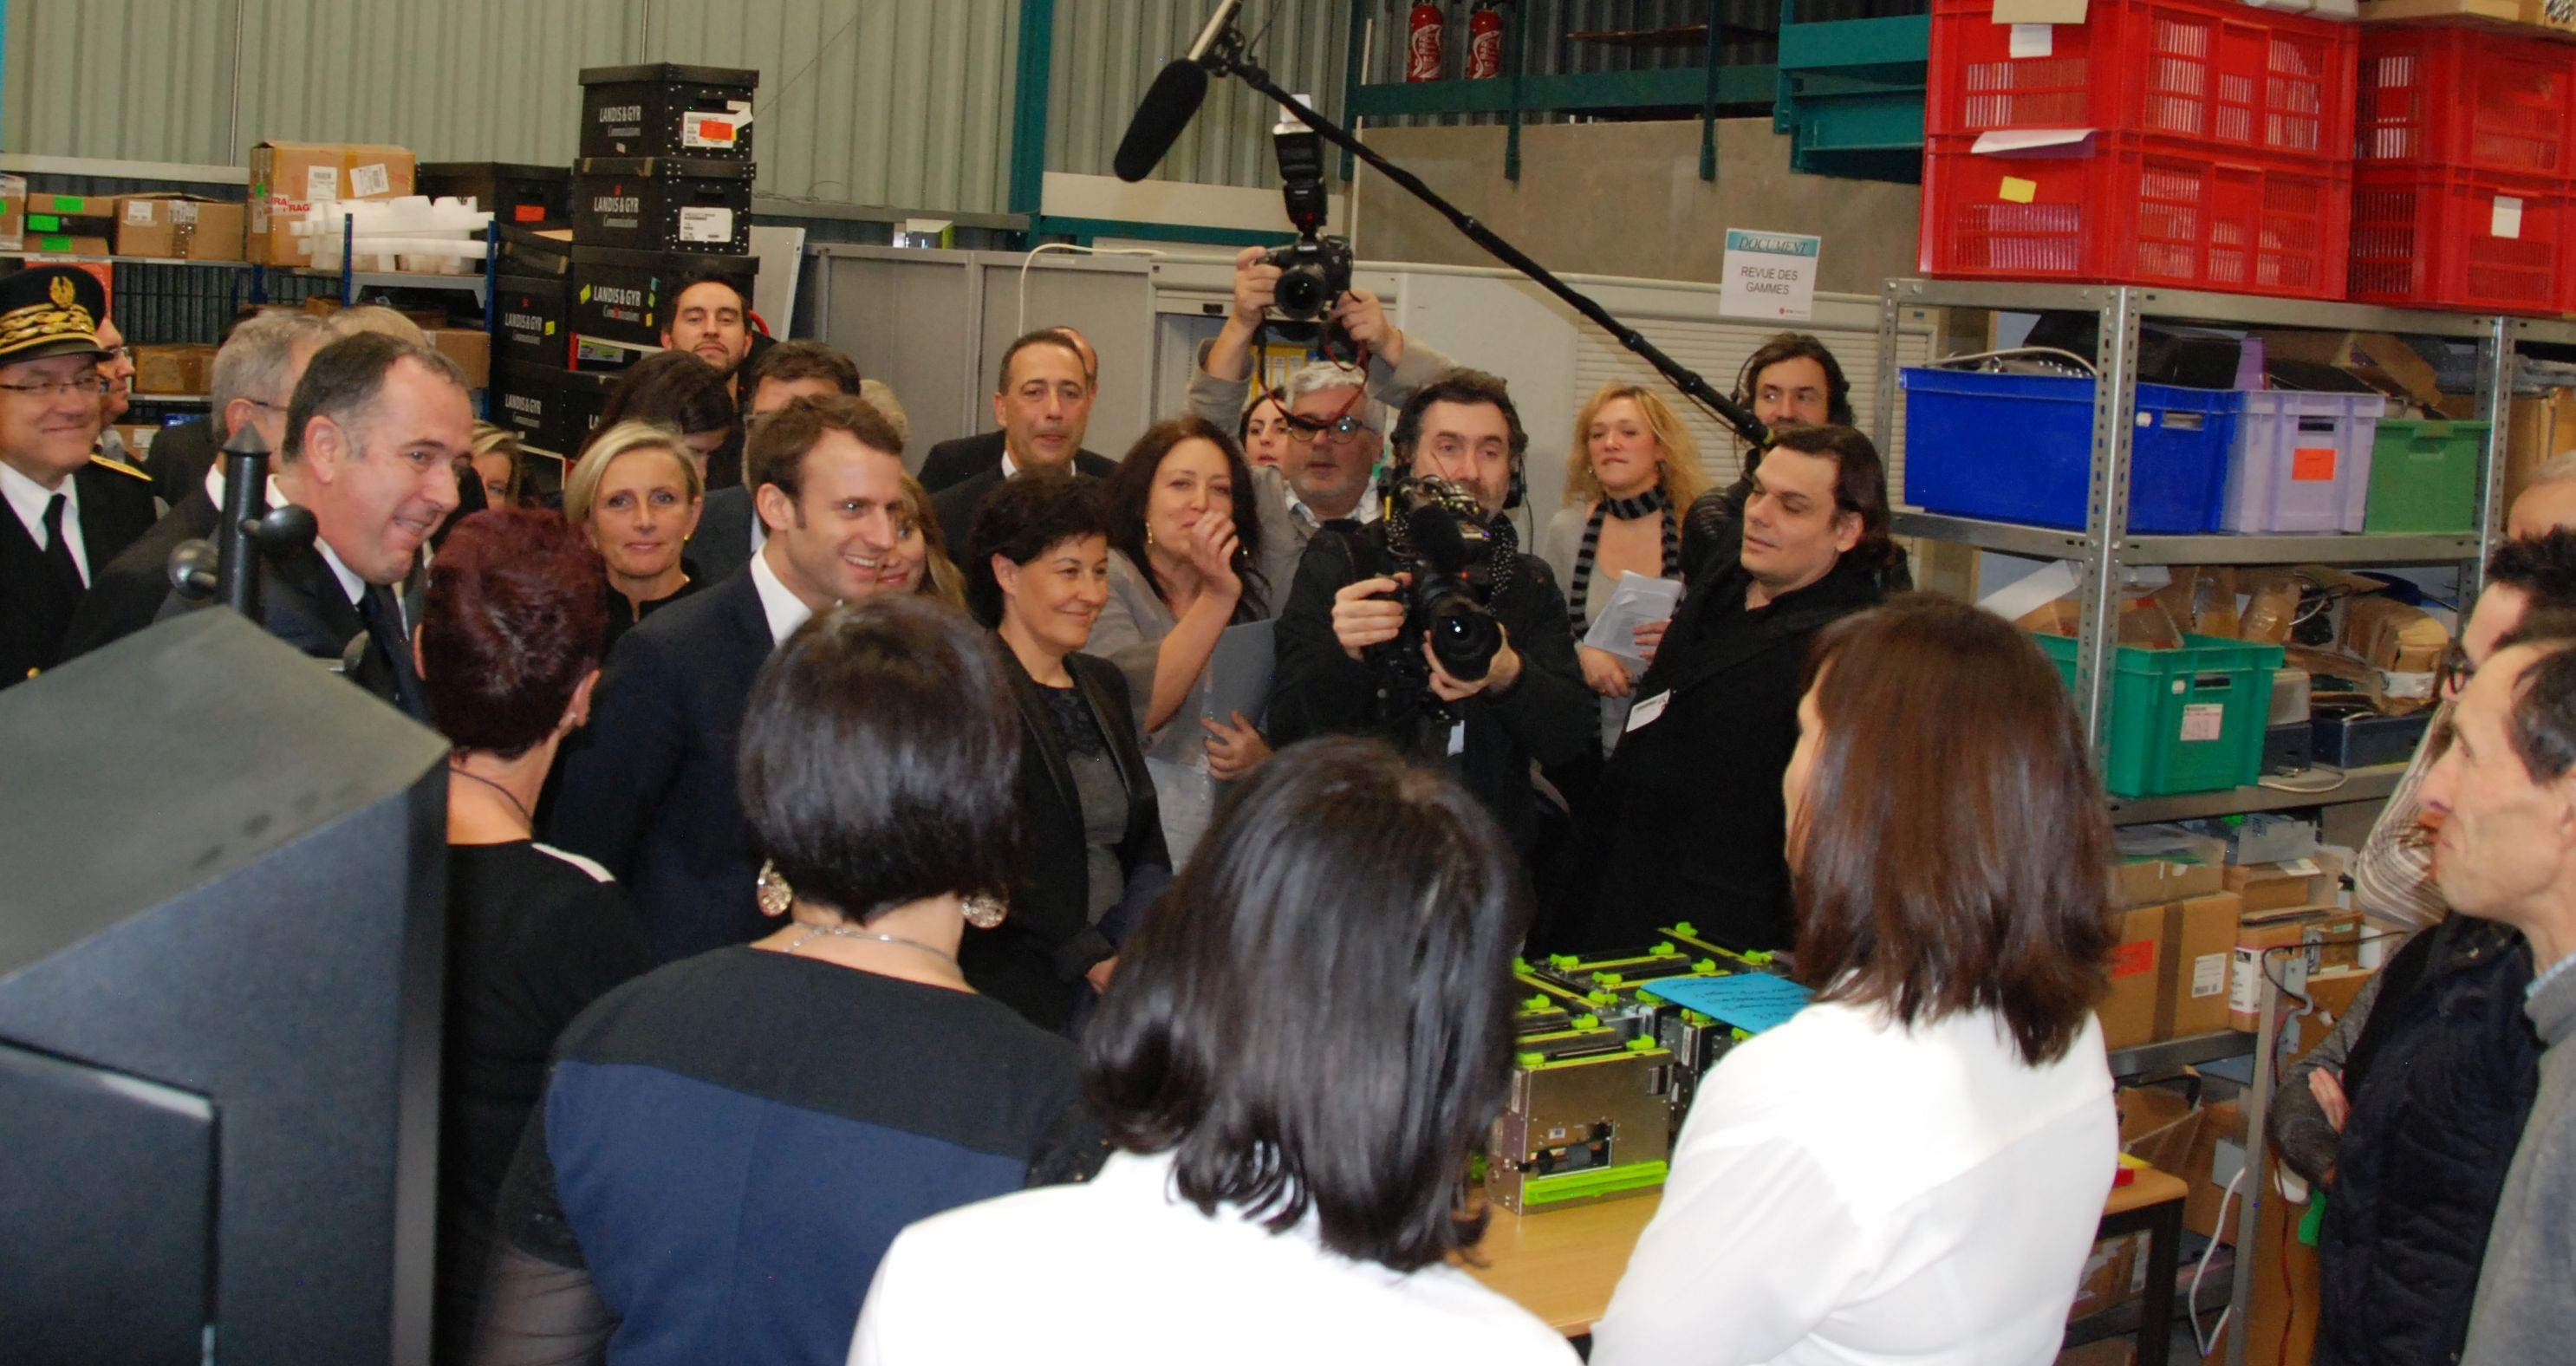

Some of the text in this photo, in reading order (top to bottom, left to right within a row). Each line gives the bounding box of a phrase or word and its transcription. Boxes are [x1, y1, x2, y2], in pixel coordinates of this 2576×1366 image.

[1738, 235, 1809, 255] DOCUMENT
[1740, 265, 1799, 282] REVUE DES
[1746, 282, 1790, 296] GAMMES
